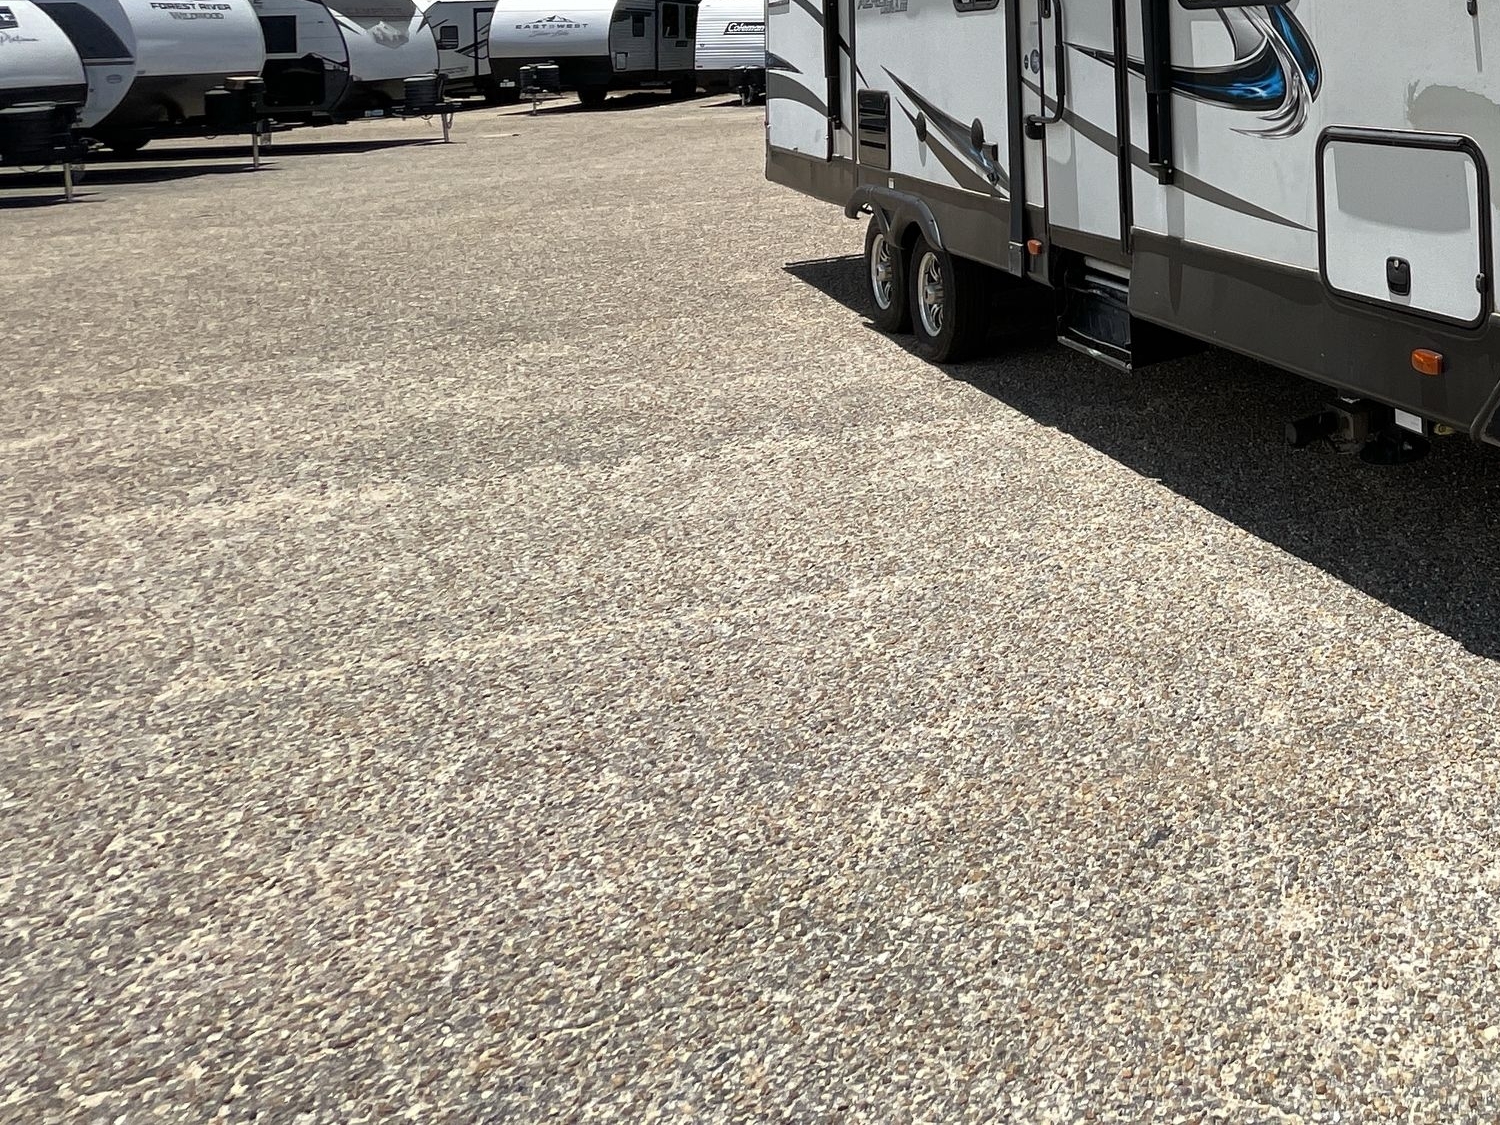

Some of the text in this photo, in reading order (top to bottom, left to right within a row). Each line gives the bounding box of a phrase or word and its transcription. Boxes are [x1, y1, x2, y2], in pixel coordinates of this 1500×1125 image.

[150, 2, 232, 11] FOREST RIVER
[168, 11, 225, 21] WILDWOOD
[728, 22, 764, 32] Coleman
